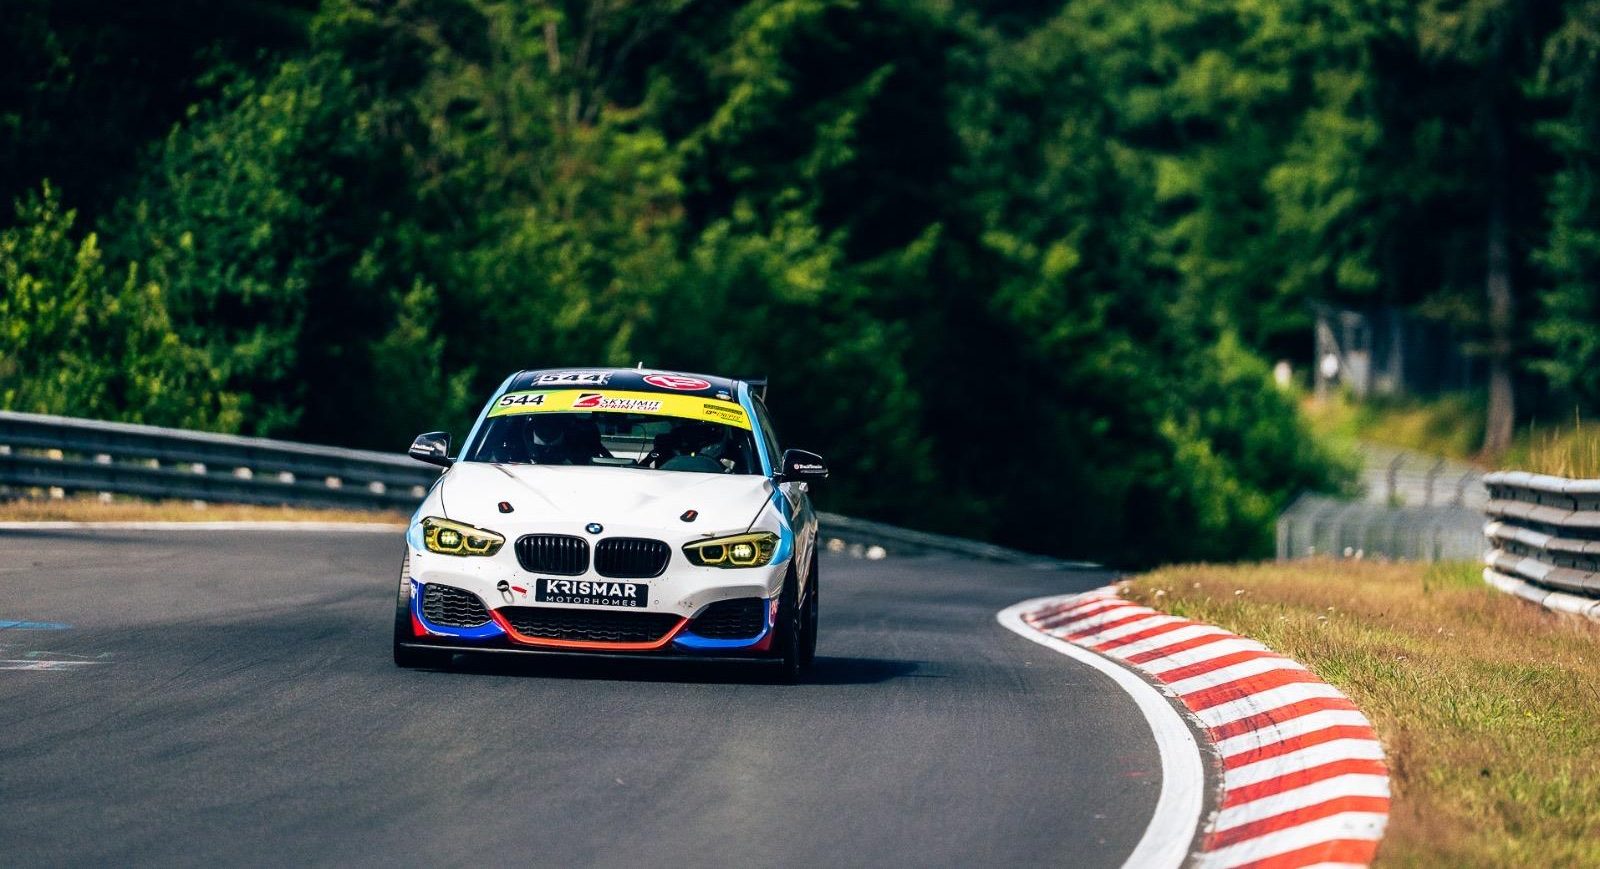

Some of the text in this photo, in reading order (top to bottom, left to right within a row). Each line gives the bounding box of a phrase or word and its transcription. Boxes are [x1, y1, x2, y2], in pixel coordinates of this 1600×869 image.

[542, 374, 601, 382] 544
[500, 395, 544, 406] 544
[602, 399, 660, 407] SKYLIMIT
[546, 580, 637, 598] KRISMAR
[546, 595, 637, 607] MOTORHOMES
